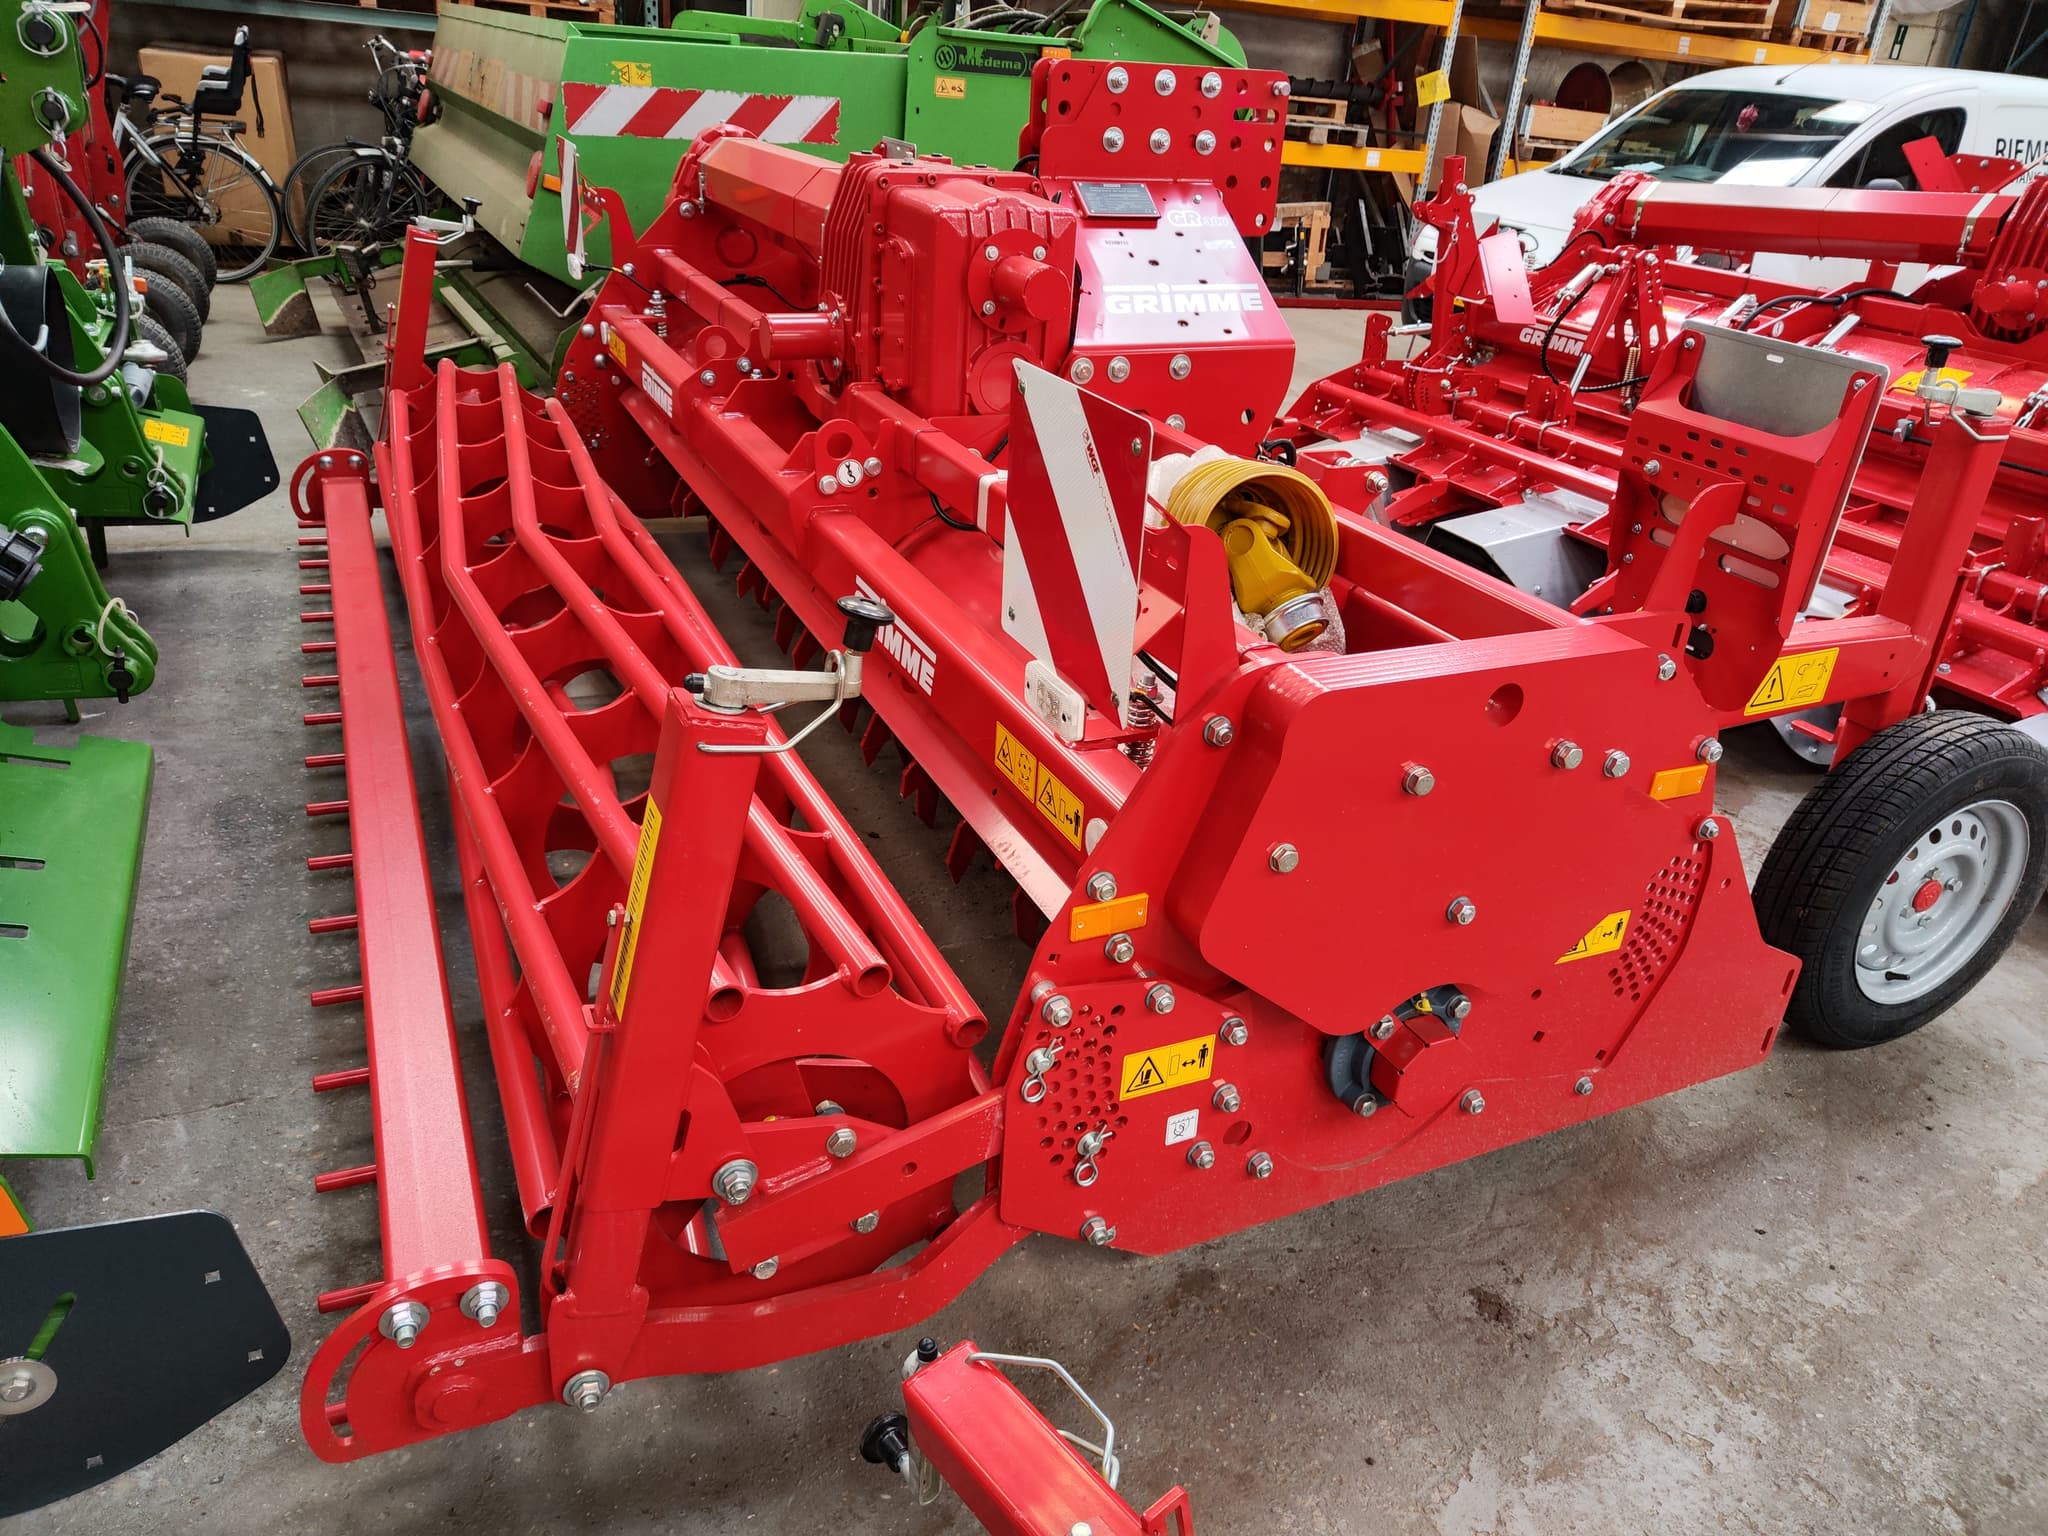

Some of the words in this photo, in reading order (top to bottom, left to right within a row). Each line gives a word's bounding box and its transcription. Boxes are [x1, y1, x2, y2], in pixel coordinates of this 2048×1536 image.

[958, 53, 1022, 70] Miedema
[1103, 283, 1264, 314] GRIMME
[1519, 326, 1585, 357] GRMM
[641, 361, 673, 419] GRIMME
